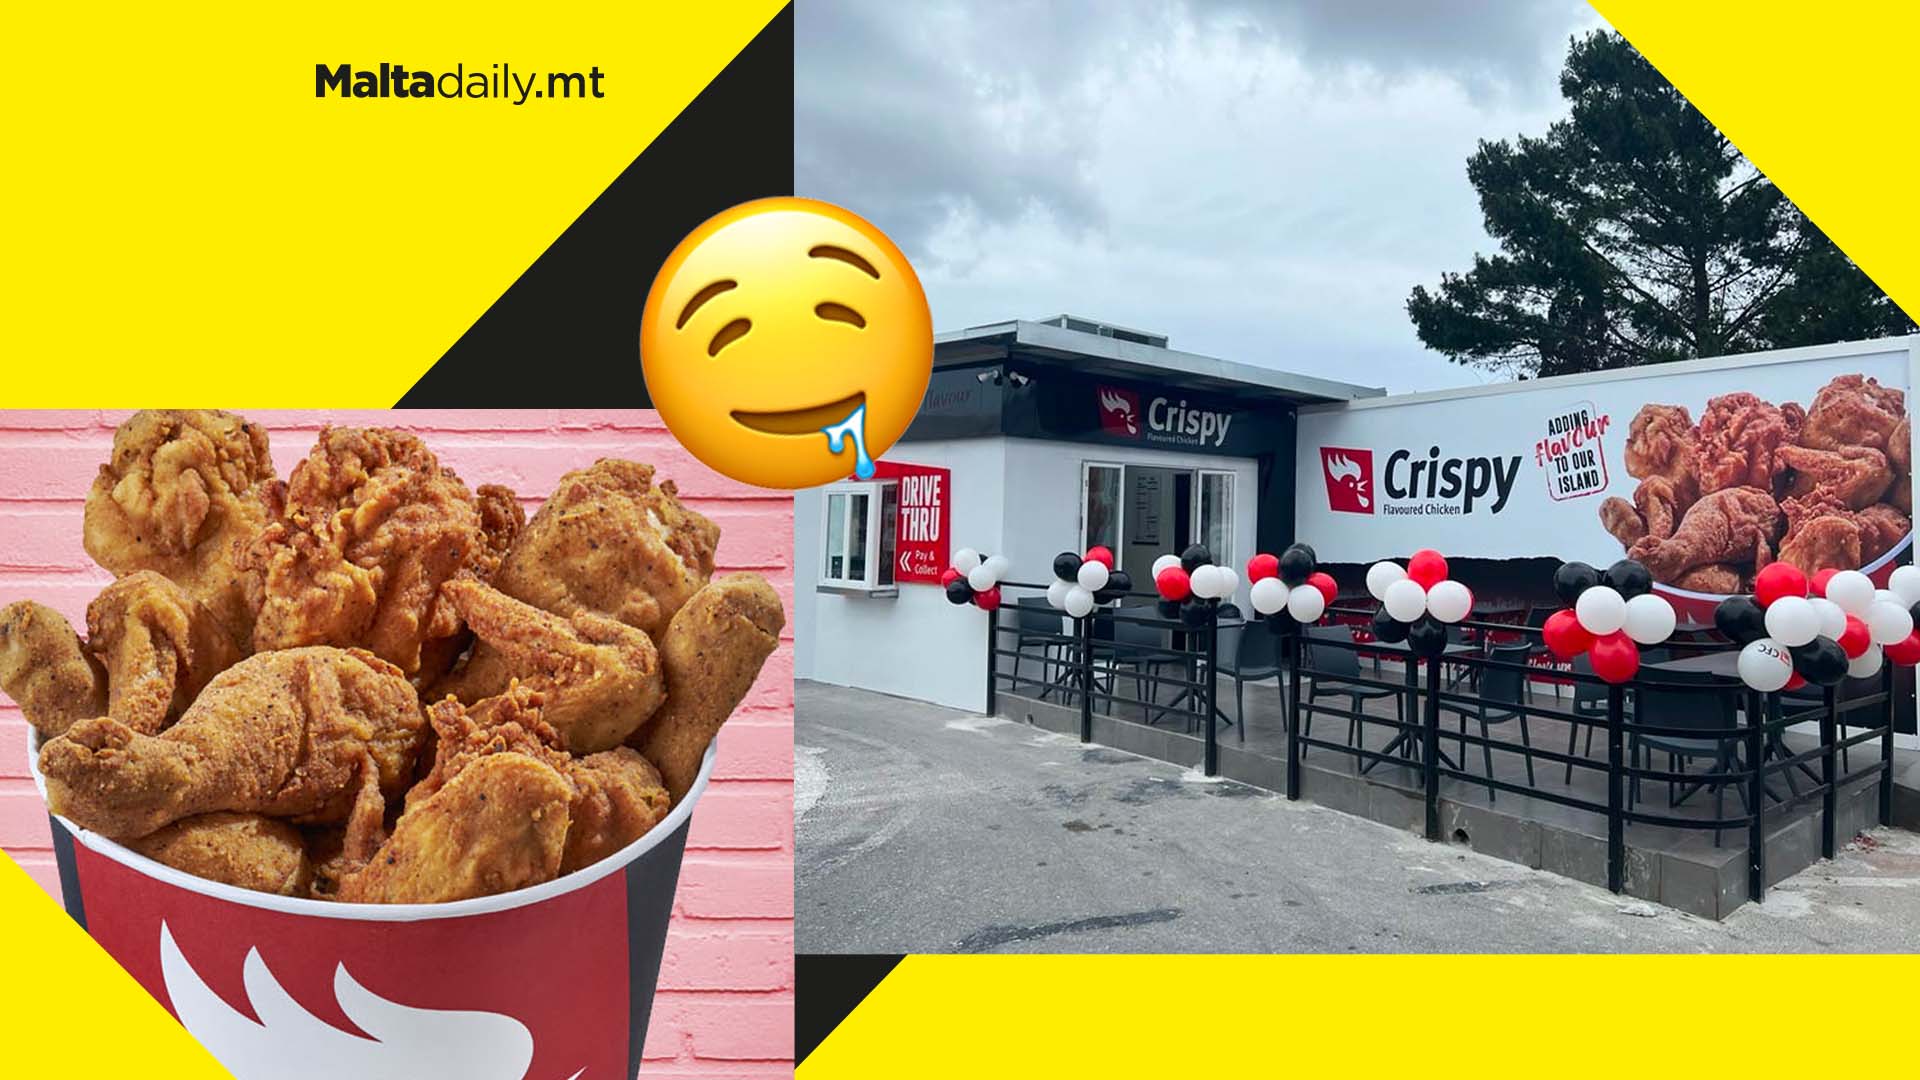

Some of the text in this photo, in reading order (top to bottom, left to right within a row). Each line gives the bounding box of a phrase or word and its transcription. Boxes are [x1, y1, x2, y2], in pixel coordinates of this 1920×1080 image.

[1148, 397, 1232, 447] Crispy
[1548, 409, 1589, 436] ADDING
[1554, 449, 1596, 474] TO OUR
[901, 475, 942, 507] DRIVE
[1384, 445, 1523, 515] Crispy
[1558, 469, 1600, 494] ISLAND
[1383, 503, 1461, 516] Flavoured Chicken
[901, 507, 941, 542] THRU
[915, 550, 929, 563] Pay
[914, 564, 938, 576] Collect
